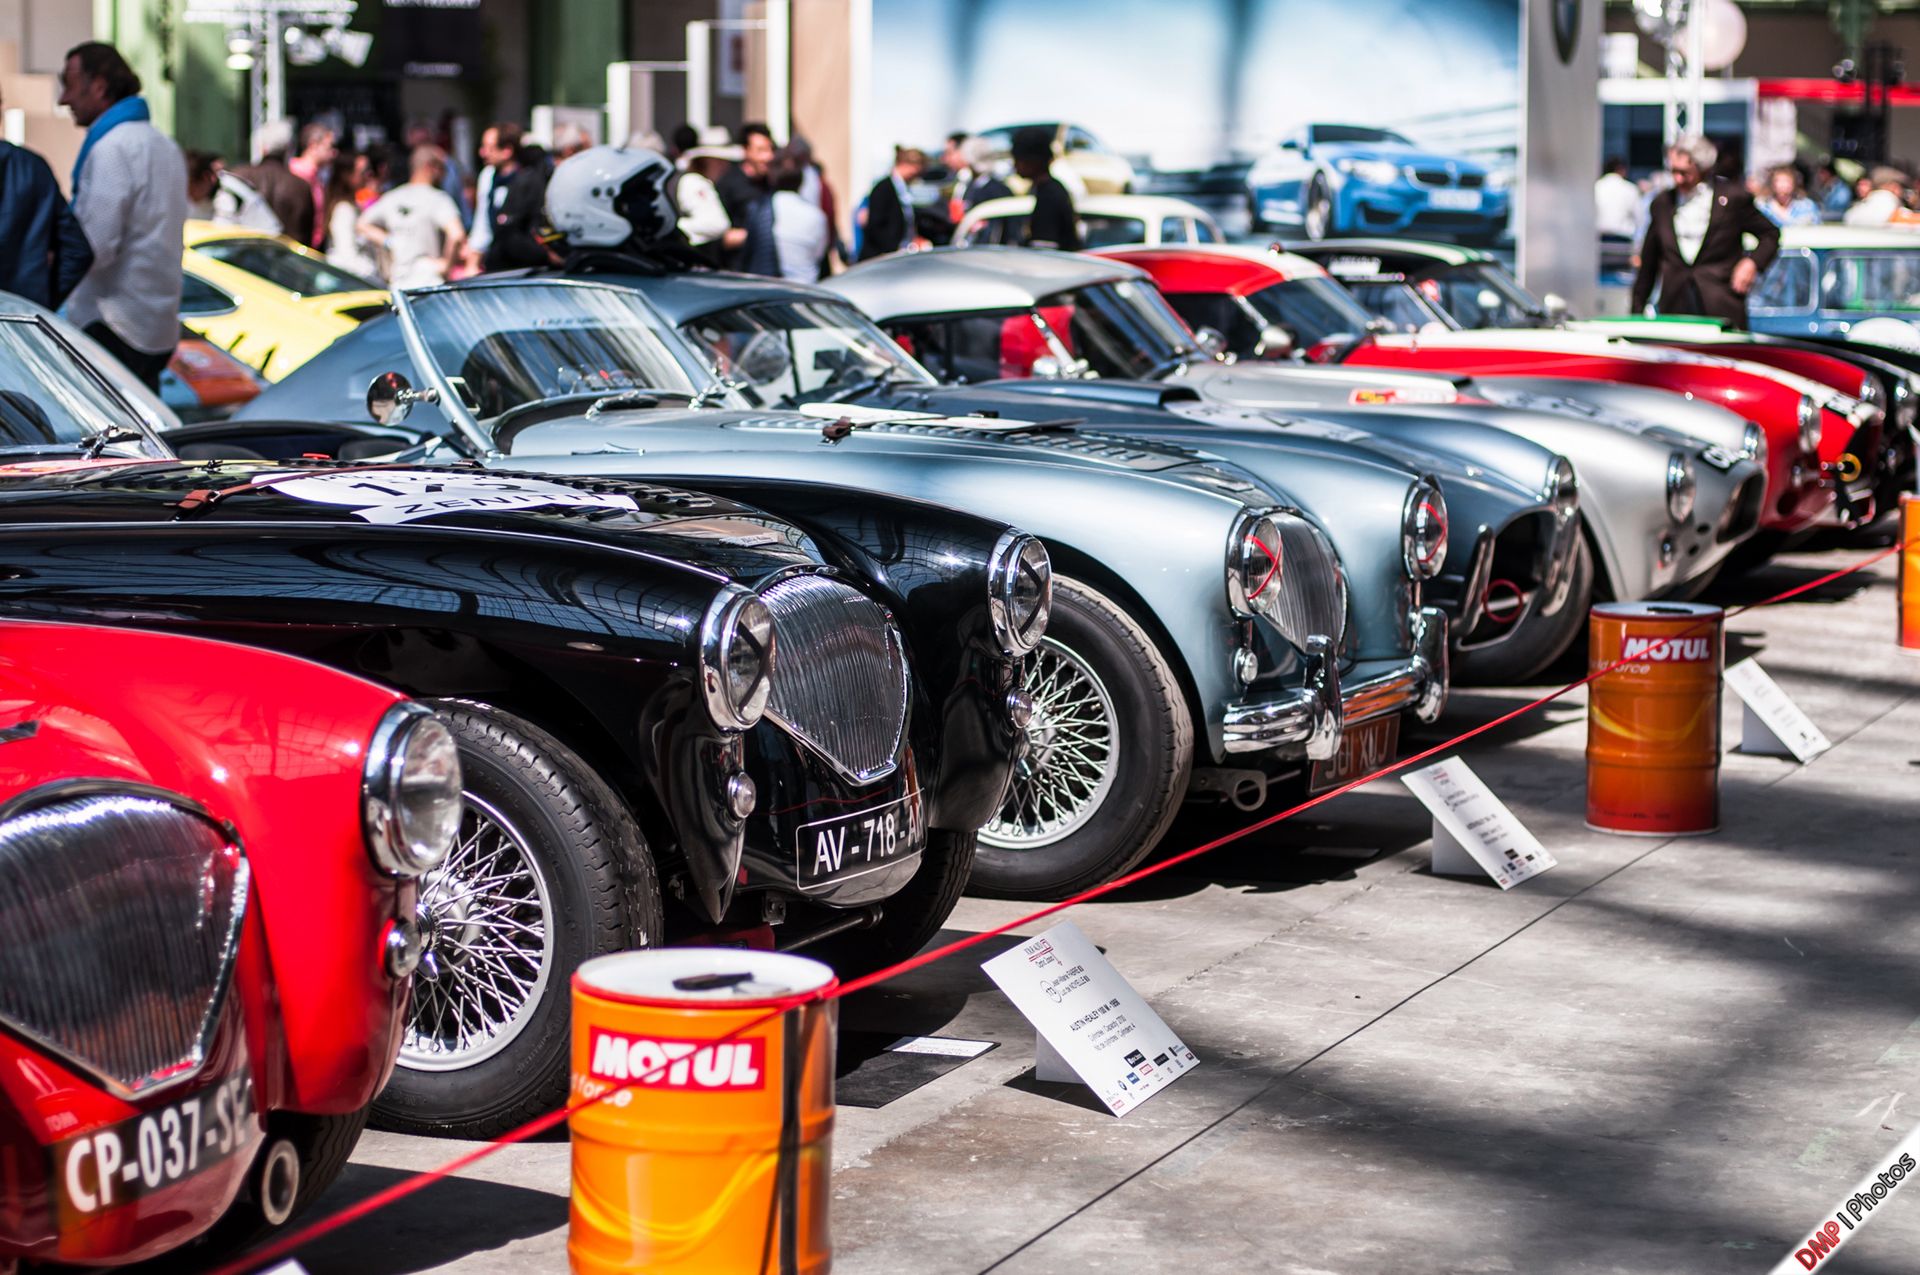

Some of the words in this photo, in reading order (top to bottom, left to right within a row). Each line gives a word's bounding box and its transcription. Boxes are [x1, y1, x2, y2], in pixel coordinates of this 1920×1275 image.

[394, 494, 606, 514] ZENITH
[1624, 638, 1709, 660] MOTUL
[592, 1034, 759, 1087] MOTUL
